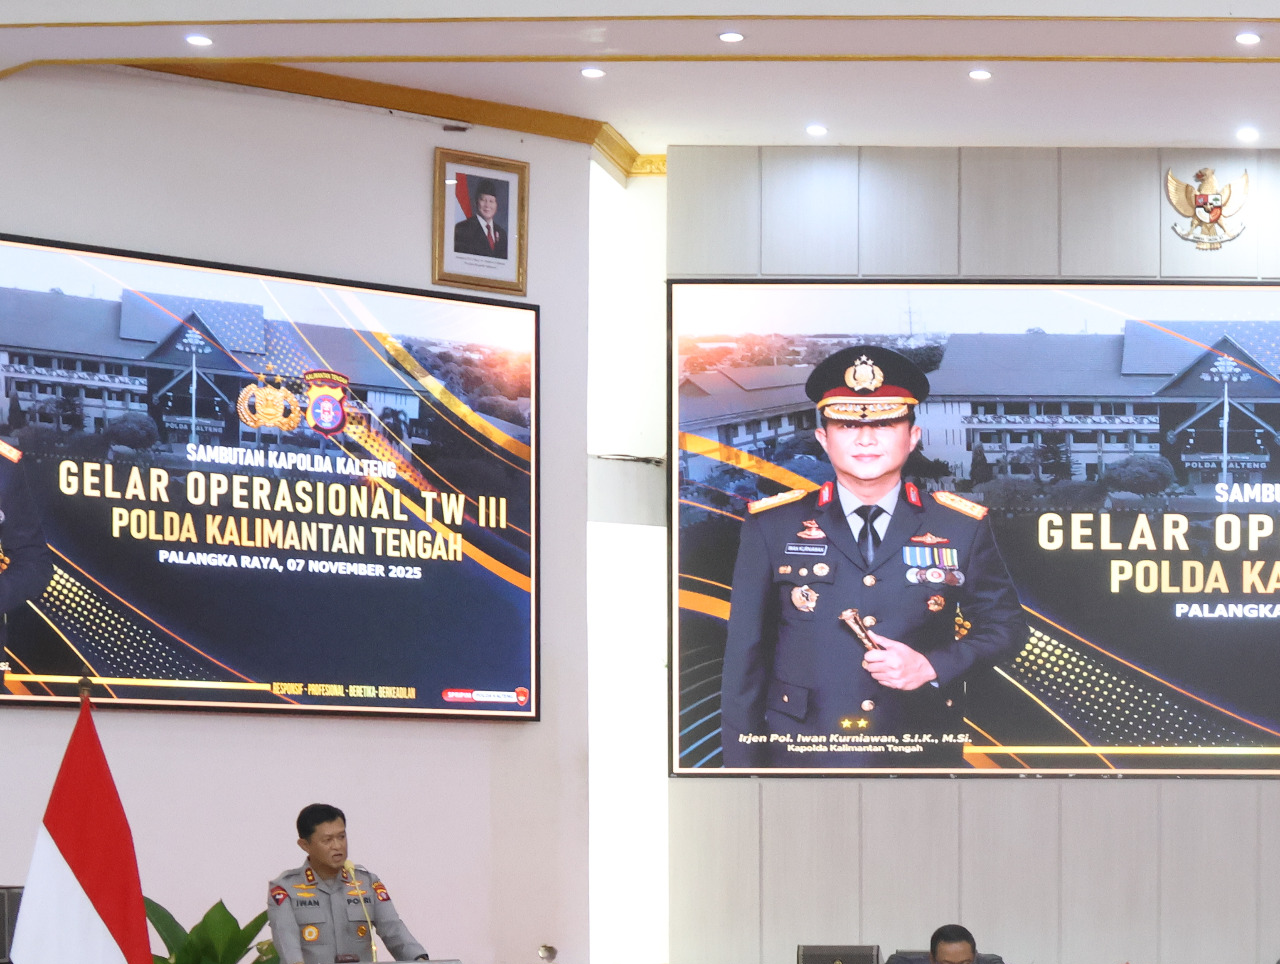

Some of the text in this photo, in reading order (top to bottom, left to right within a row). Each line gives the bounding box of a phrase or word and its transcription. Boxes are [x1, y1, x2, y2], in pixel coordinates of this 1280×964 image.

[191, 423, 223, 433] ALTENG
[186, 443, 397, 479] SAMBUTAN KAPOLDA KALTENG
[1185, 461, 1217, 469] POLDA
[59, 460, 507, 529] GELAR OPERASIONAL TW III
[112, 506, 463, 562] POLDA KALIMANTAN TENGAH
[1037, 512, 1189, 551] GELAR
[158, 549, 423, 580] PALANGKA RAYA, 07 NOVEMBER 2025
[1110, 559, 1229, 593] POLDA
[738, 733, 768, 745] Irjen
[770, 734, 794, 743] Pol.
[797, 734, 826, 743] Iwan
[829, 734, 899, 744] Kurniawan,
[787, 744, 924, 753] Kapolda Kalimantan Tengah
